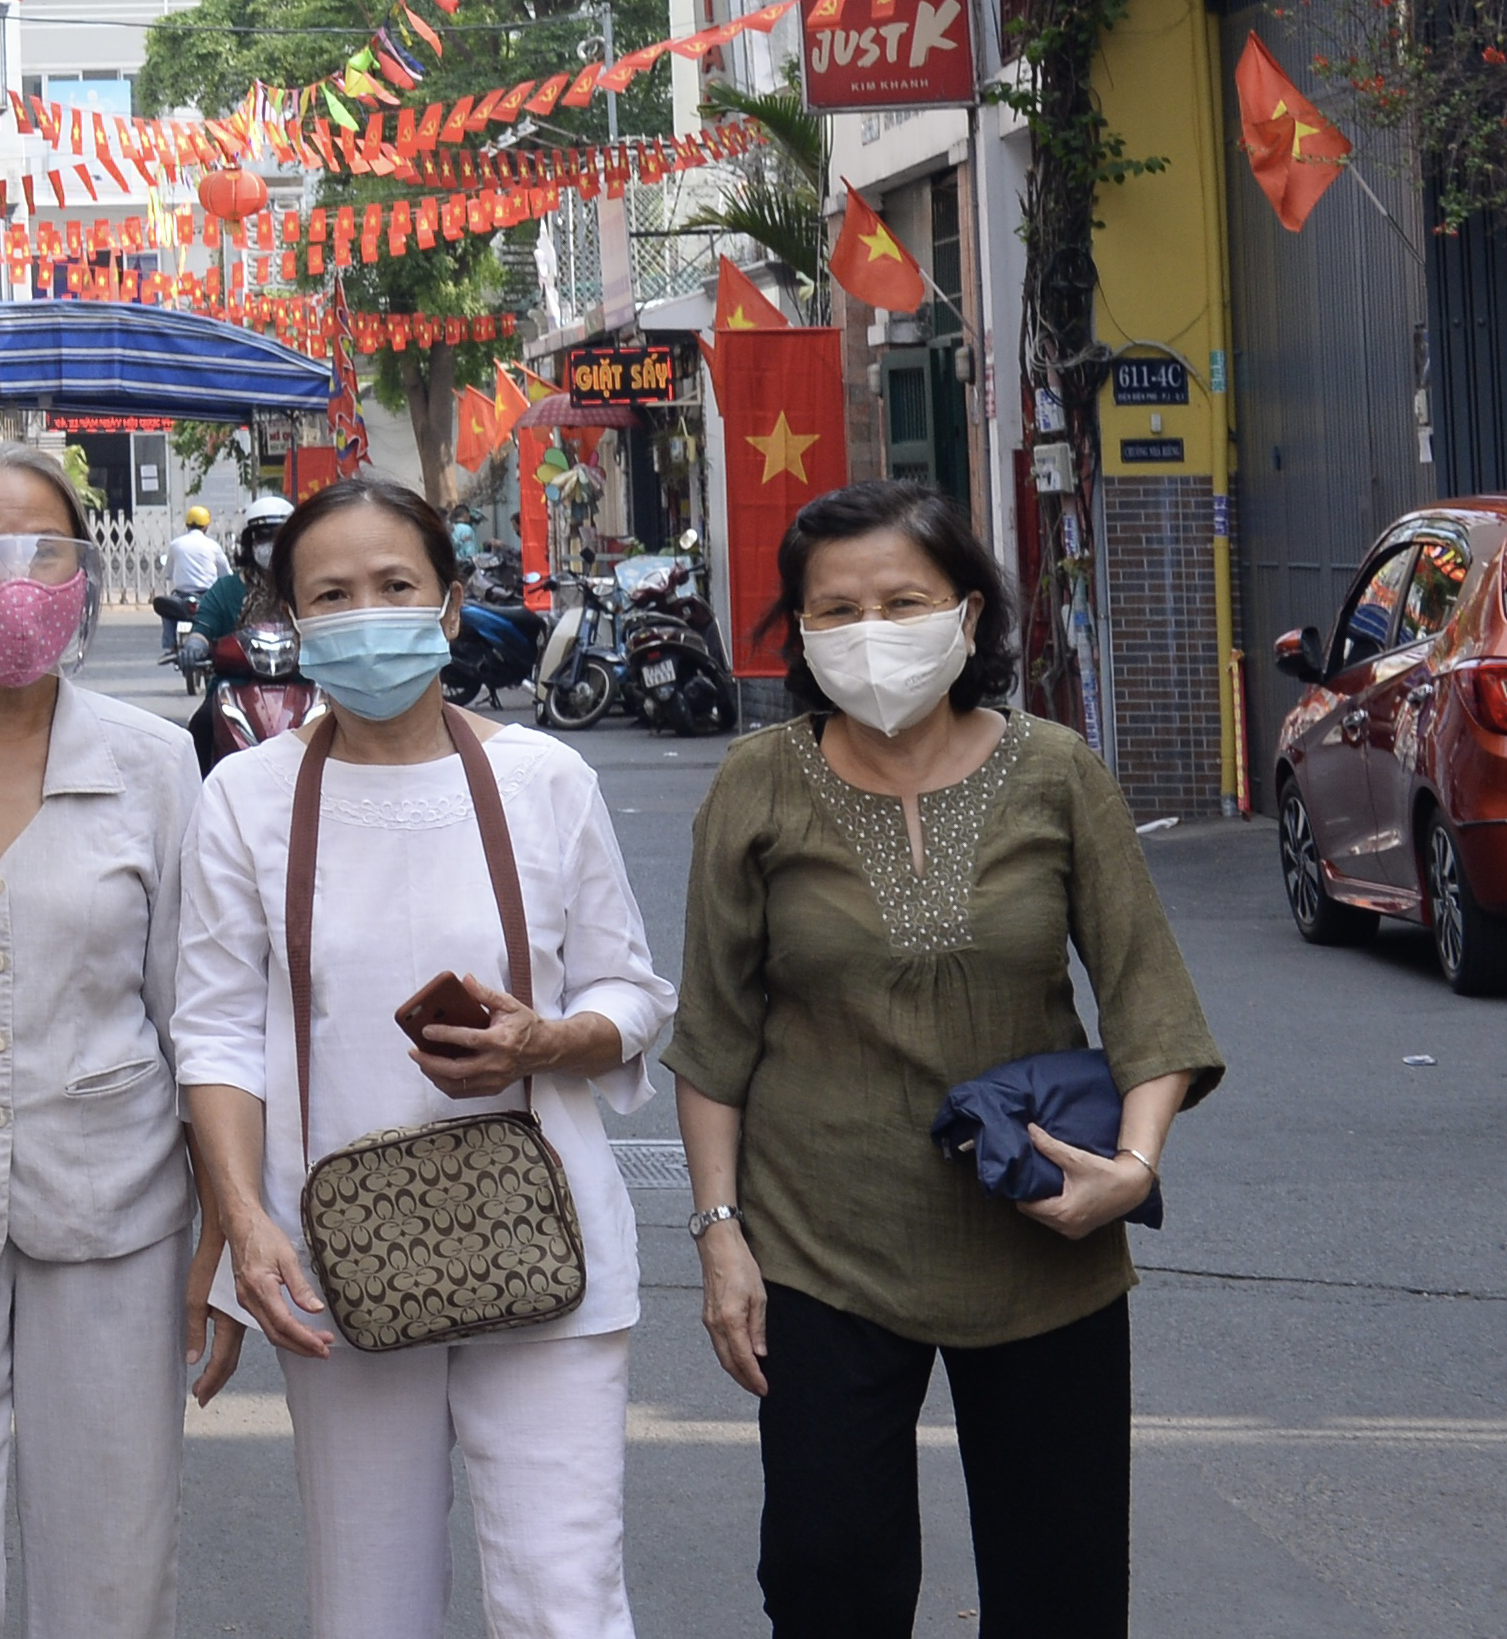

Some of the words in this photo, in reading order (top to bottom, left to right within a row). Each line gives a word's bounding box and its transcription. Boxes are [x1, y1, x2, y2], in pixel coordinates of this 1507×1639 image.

[812, 22, 910, 74] JUST
[851, 82, 877, 92] KIM
[880, 78, 929, 90] KHANH
[576, 358, 623, 398] GIẶT
[630, 353, 668, 389] SẤY
